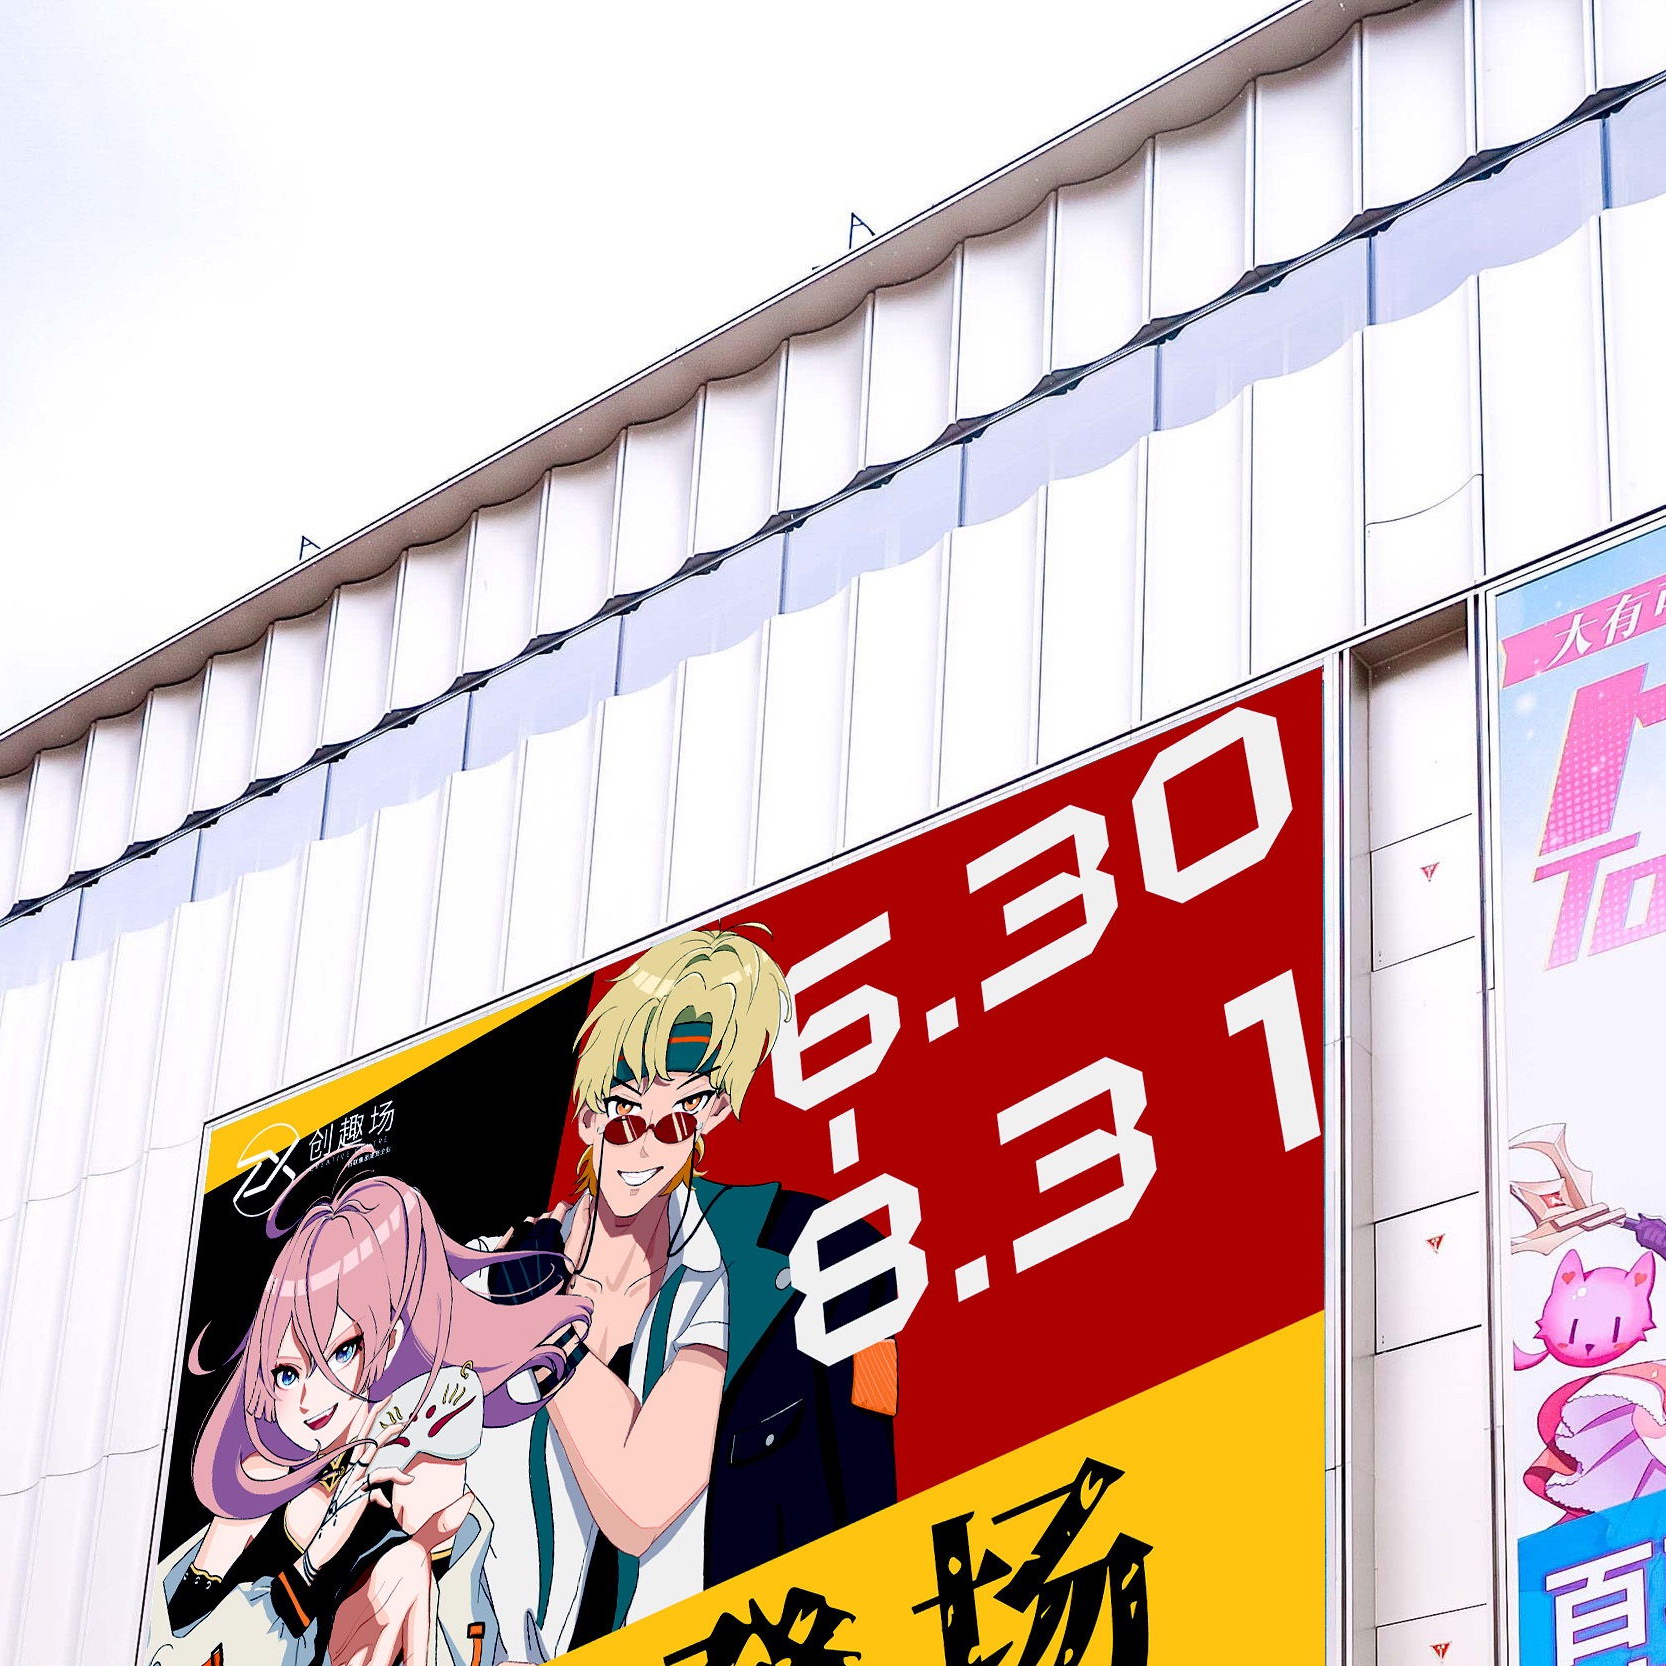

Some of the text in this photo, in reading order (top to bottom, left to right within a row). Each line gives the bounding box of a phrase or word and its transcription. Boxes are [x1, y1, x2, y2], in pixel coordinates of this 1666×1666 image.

[772, 706, 1294, 1112] 6.30
[308, 1099, 396, 1162] 创趣场
[794, 970, 1324, 1368] 8.31
